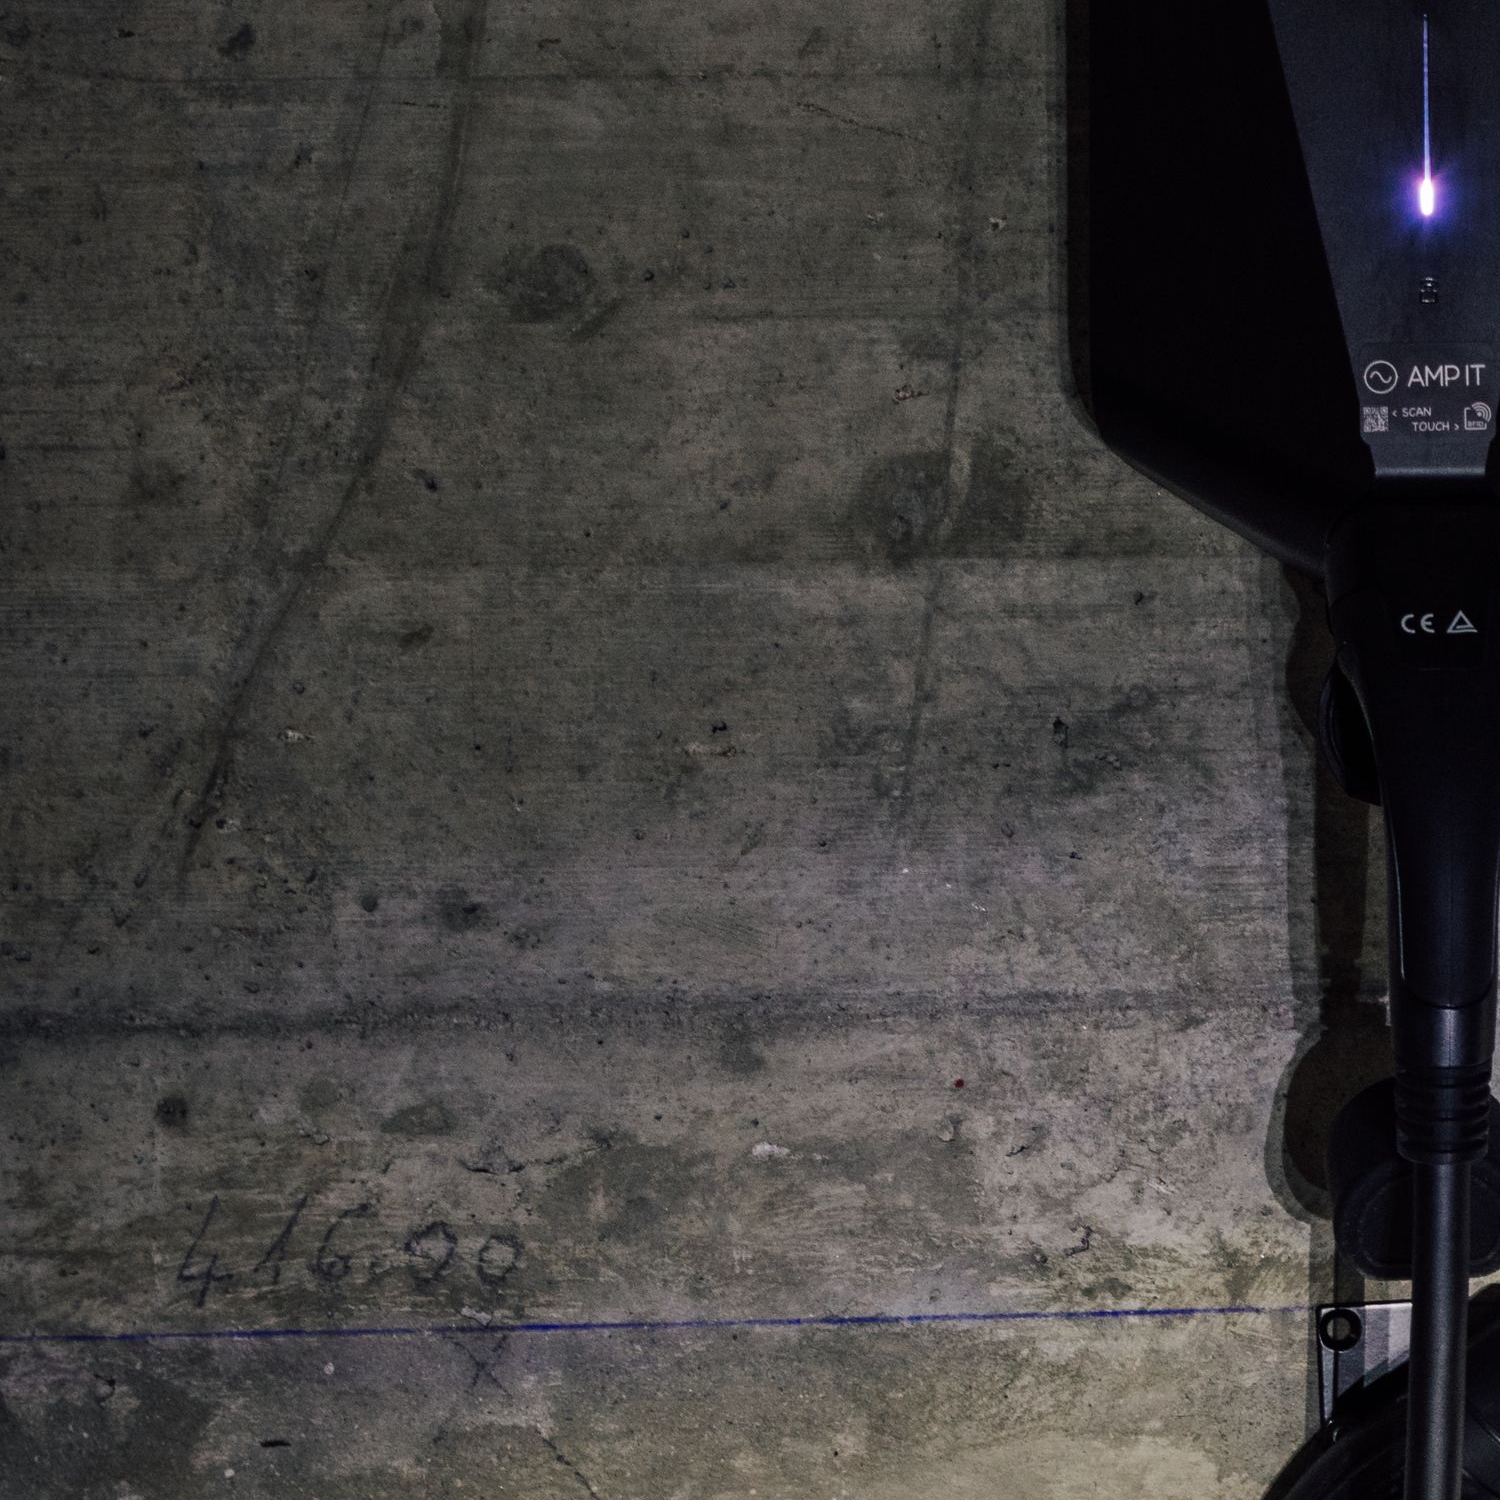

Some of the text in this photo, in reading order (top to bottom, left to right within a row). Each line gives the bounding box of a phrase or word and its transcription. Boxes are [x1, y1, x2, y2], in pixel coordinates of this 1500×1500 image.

[1407, 363, 1486, 388] AMP IT
[1402, 407, 1432, 418] SCAN
[1411, 421, 1450, 432] TOUCH
[1400, 612, 1436, 635] CE
